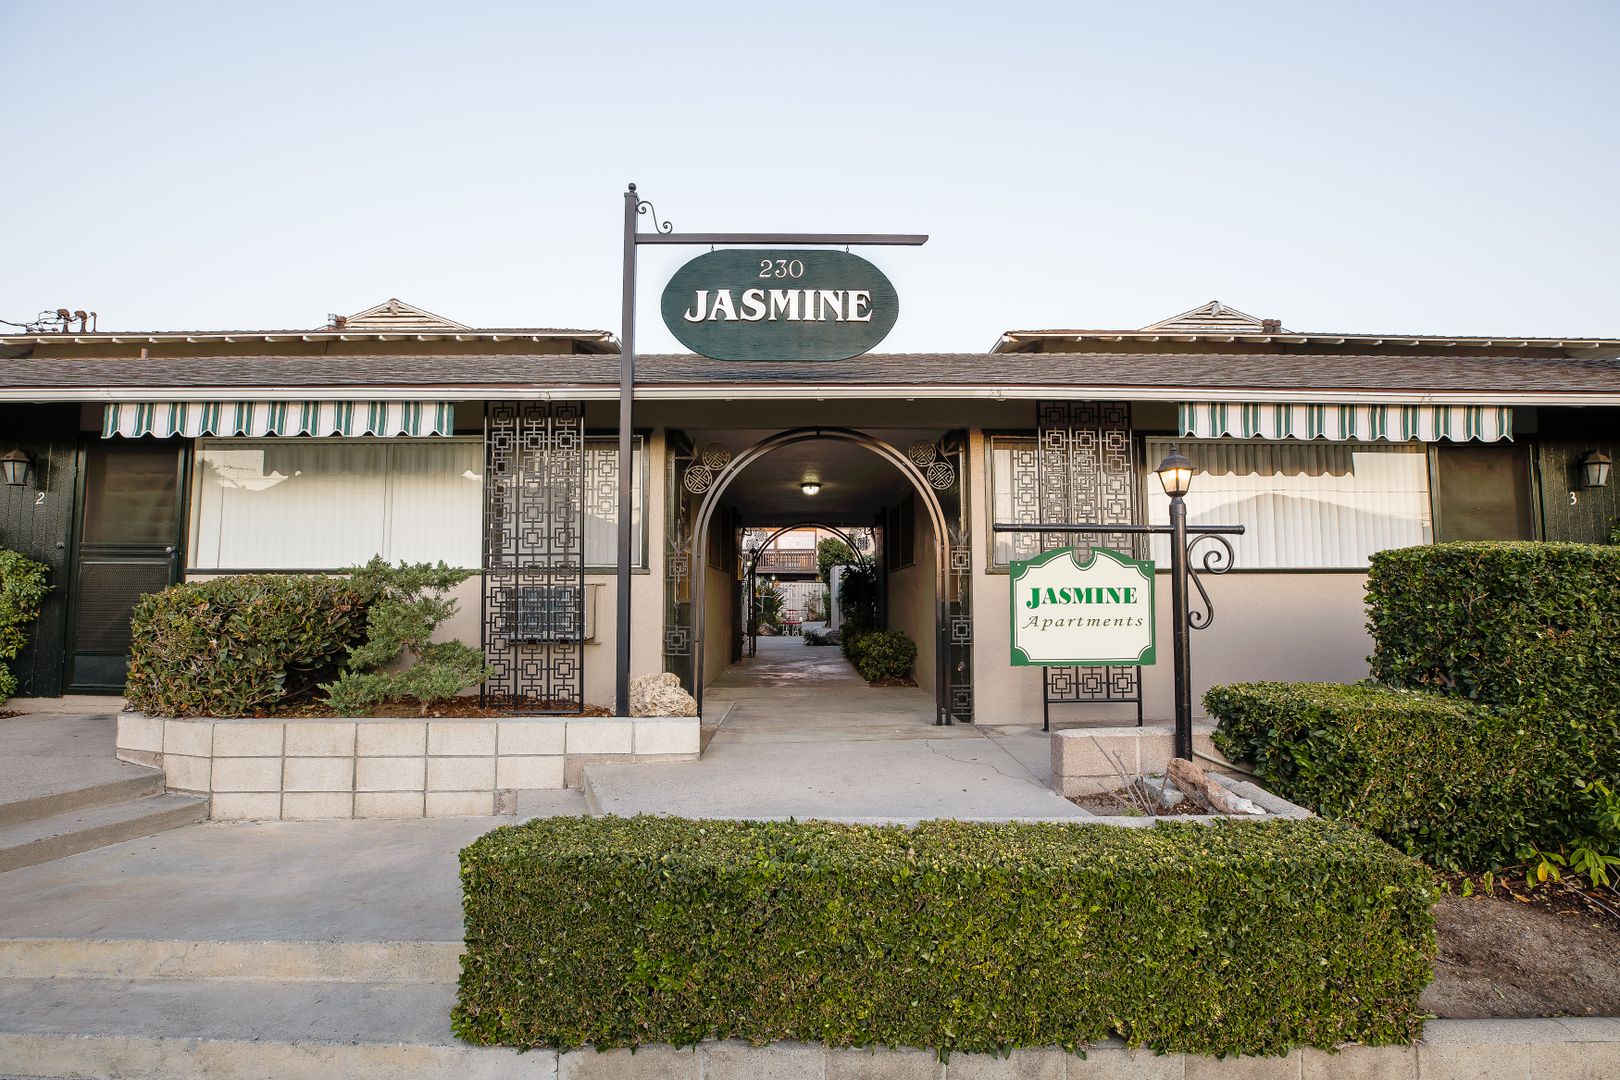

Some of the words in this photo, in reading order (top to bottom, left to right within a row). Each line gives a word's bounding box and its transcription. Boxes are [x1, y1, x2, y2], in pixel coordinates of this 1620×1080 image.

[759, 259, 804, 279] 230
[683, 288, 873, 323] JASMINE
[35, 491, 46, 505] 2
[1569, 491, 1578, 506] 3
[1026, 587, 1137, 610] JASMINE
[1022, 615, 1144, 632] Apartments
